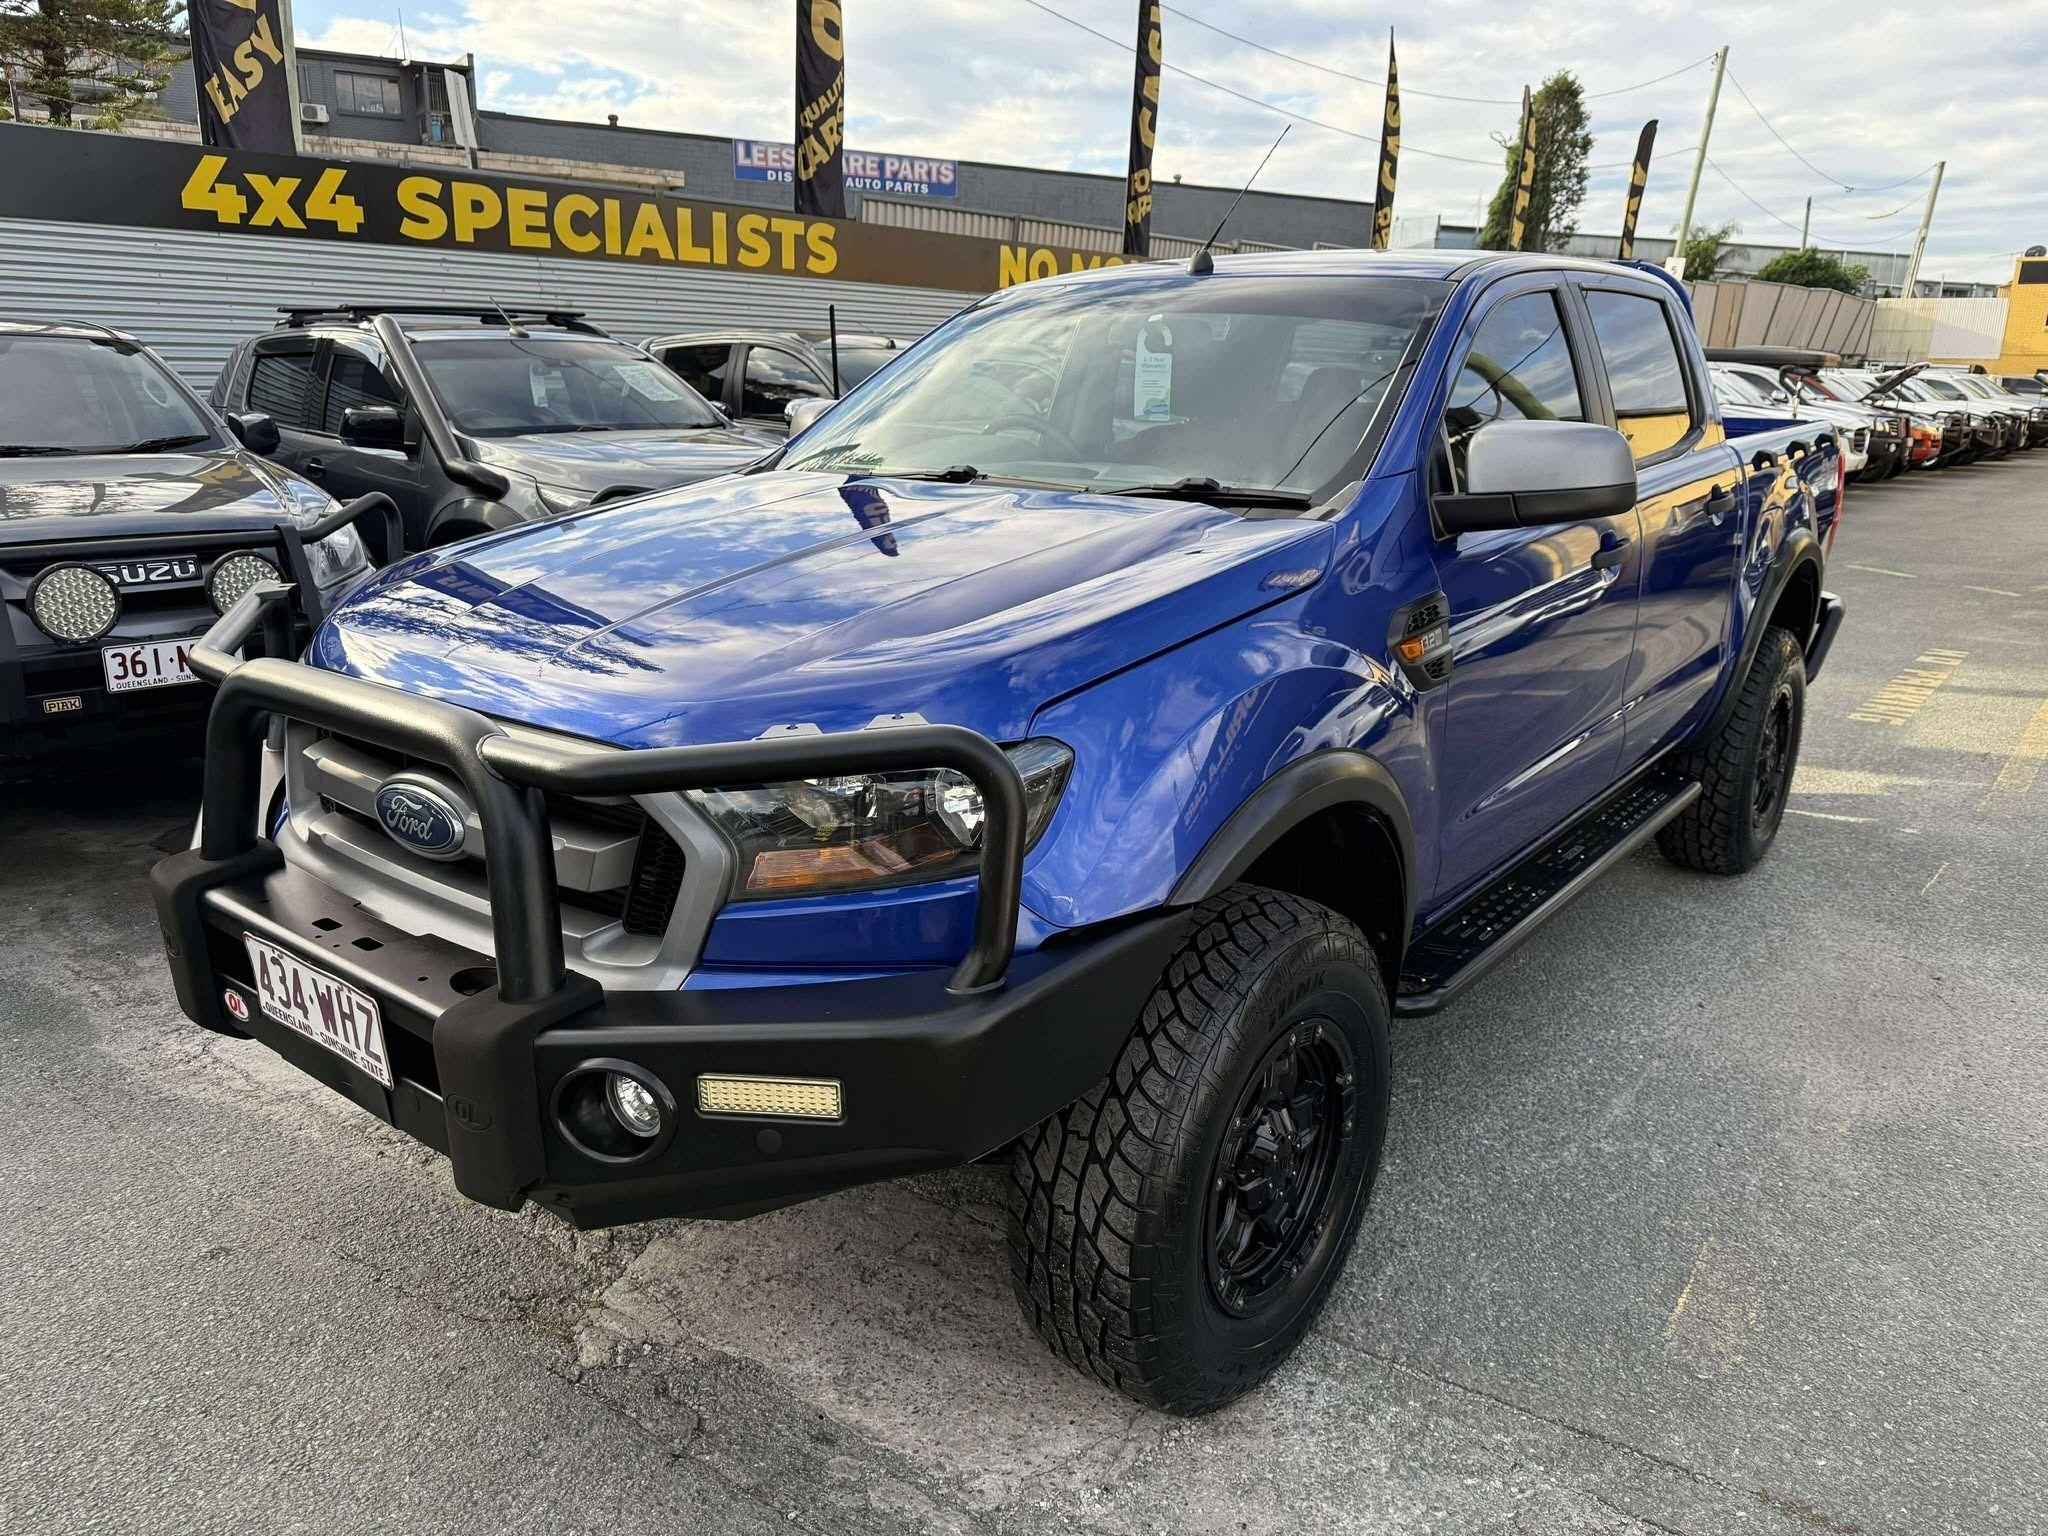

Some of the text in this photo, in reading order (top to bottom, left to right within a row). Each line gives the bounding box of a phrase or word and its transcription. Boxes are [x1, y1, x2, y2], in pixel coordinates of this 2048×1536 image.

[204, 13, 283, 124] EASY
[736, 140, 794, 170] LEES
[886, 156, 956, 185] PARTS
[845, 176, 882, 190] AUTO
[885, 179, 929, 194] PARTS
[181, 155, 838, 274] 4x4 SPECIALISTS
[999, 245, 1058, 290] NO
[97, 560, 197, 584] SUZU
[116, 675, 168, 690] QUEENSLAND
[176, 673, 197, 682] SUNS
[386, 795, 433, 840] Ford
[265, 1001, 313, 1037] QUEENSLAND
[320, 1032, 360, 1065] SUNSHINE
[361, 1057, 384, 1079] STATE
